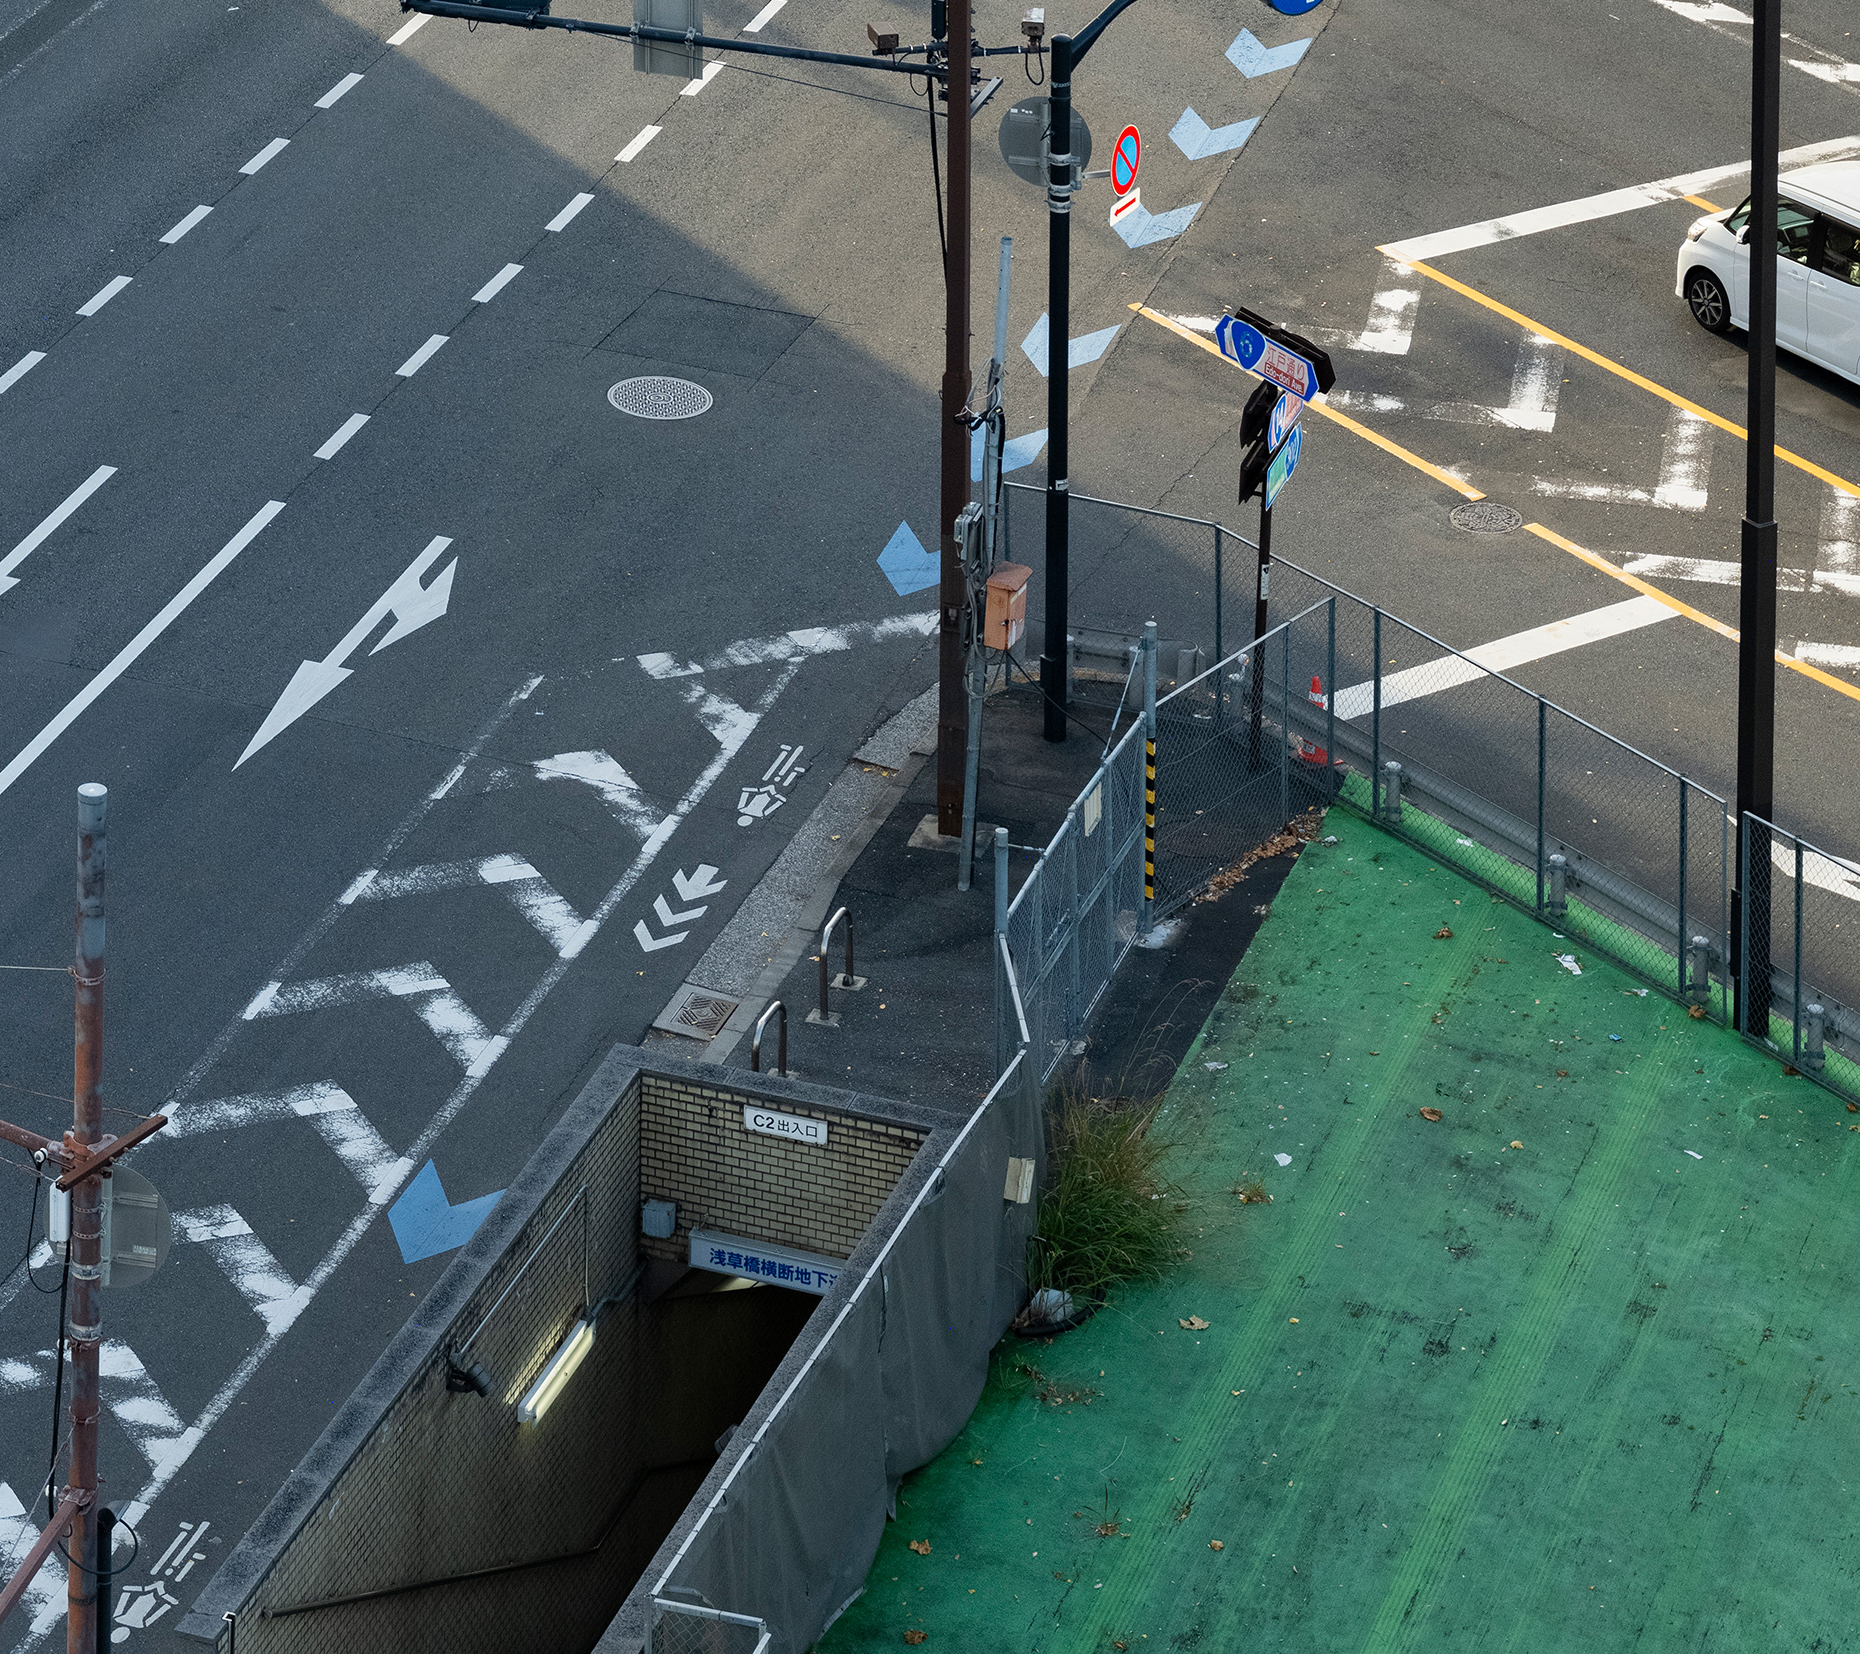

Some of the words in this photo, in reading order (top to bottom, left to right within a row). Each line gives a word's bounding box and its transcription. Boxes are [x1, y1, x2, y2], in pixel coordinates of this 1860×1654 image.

[1264, 362, 1290, 385] Edo-dori
[1266, 346, 1305, 381] 江戸通り
